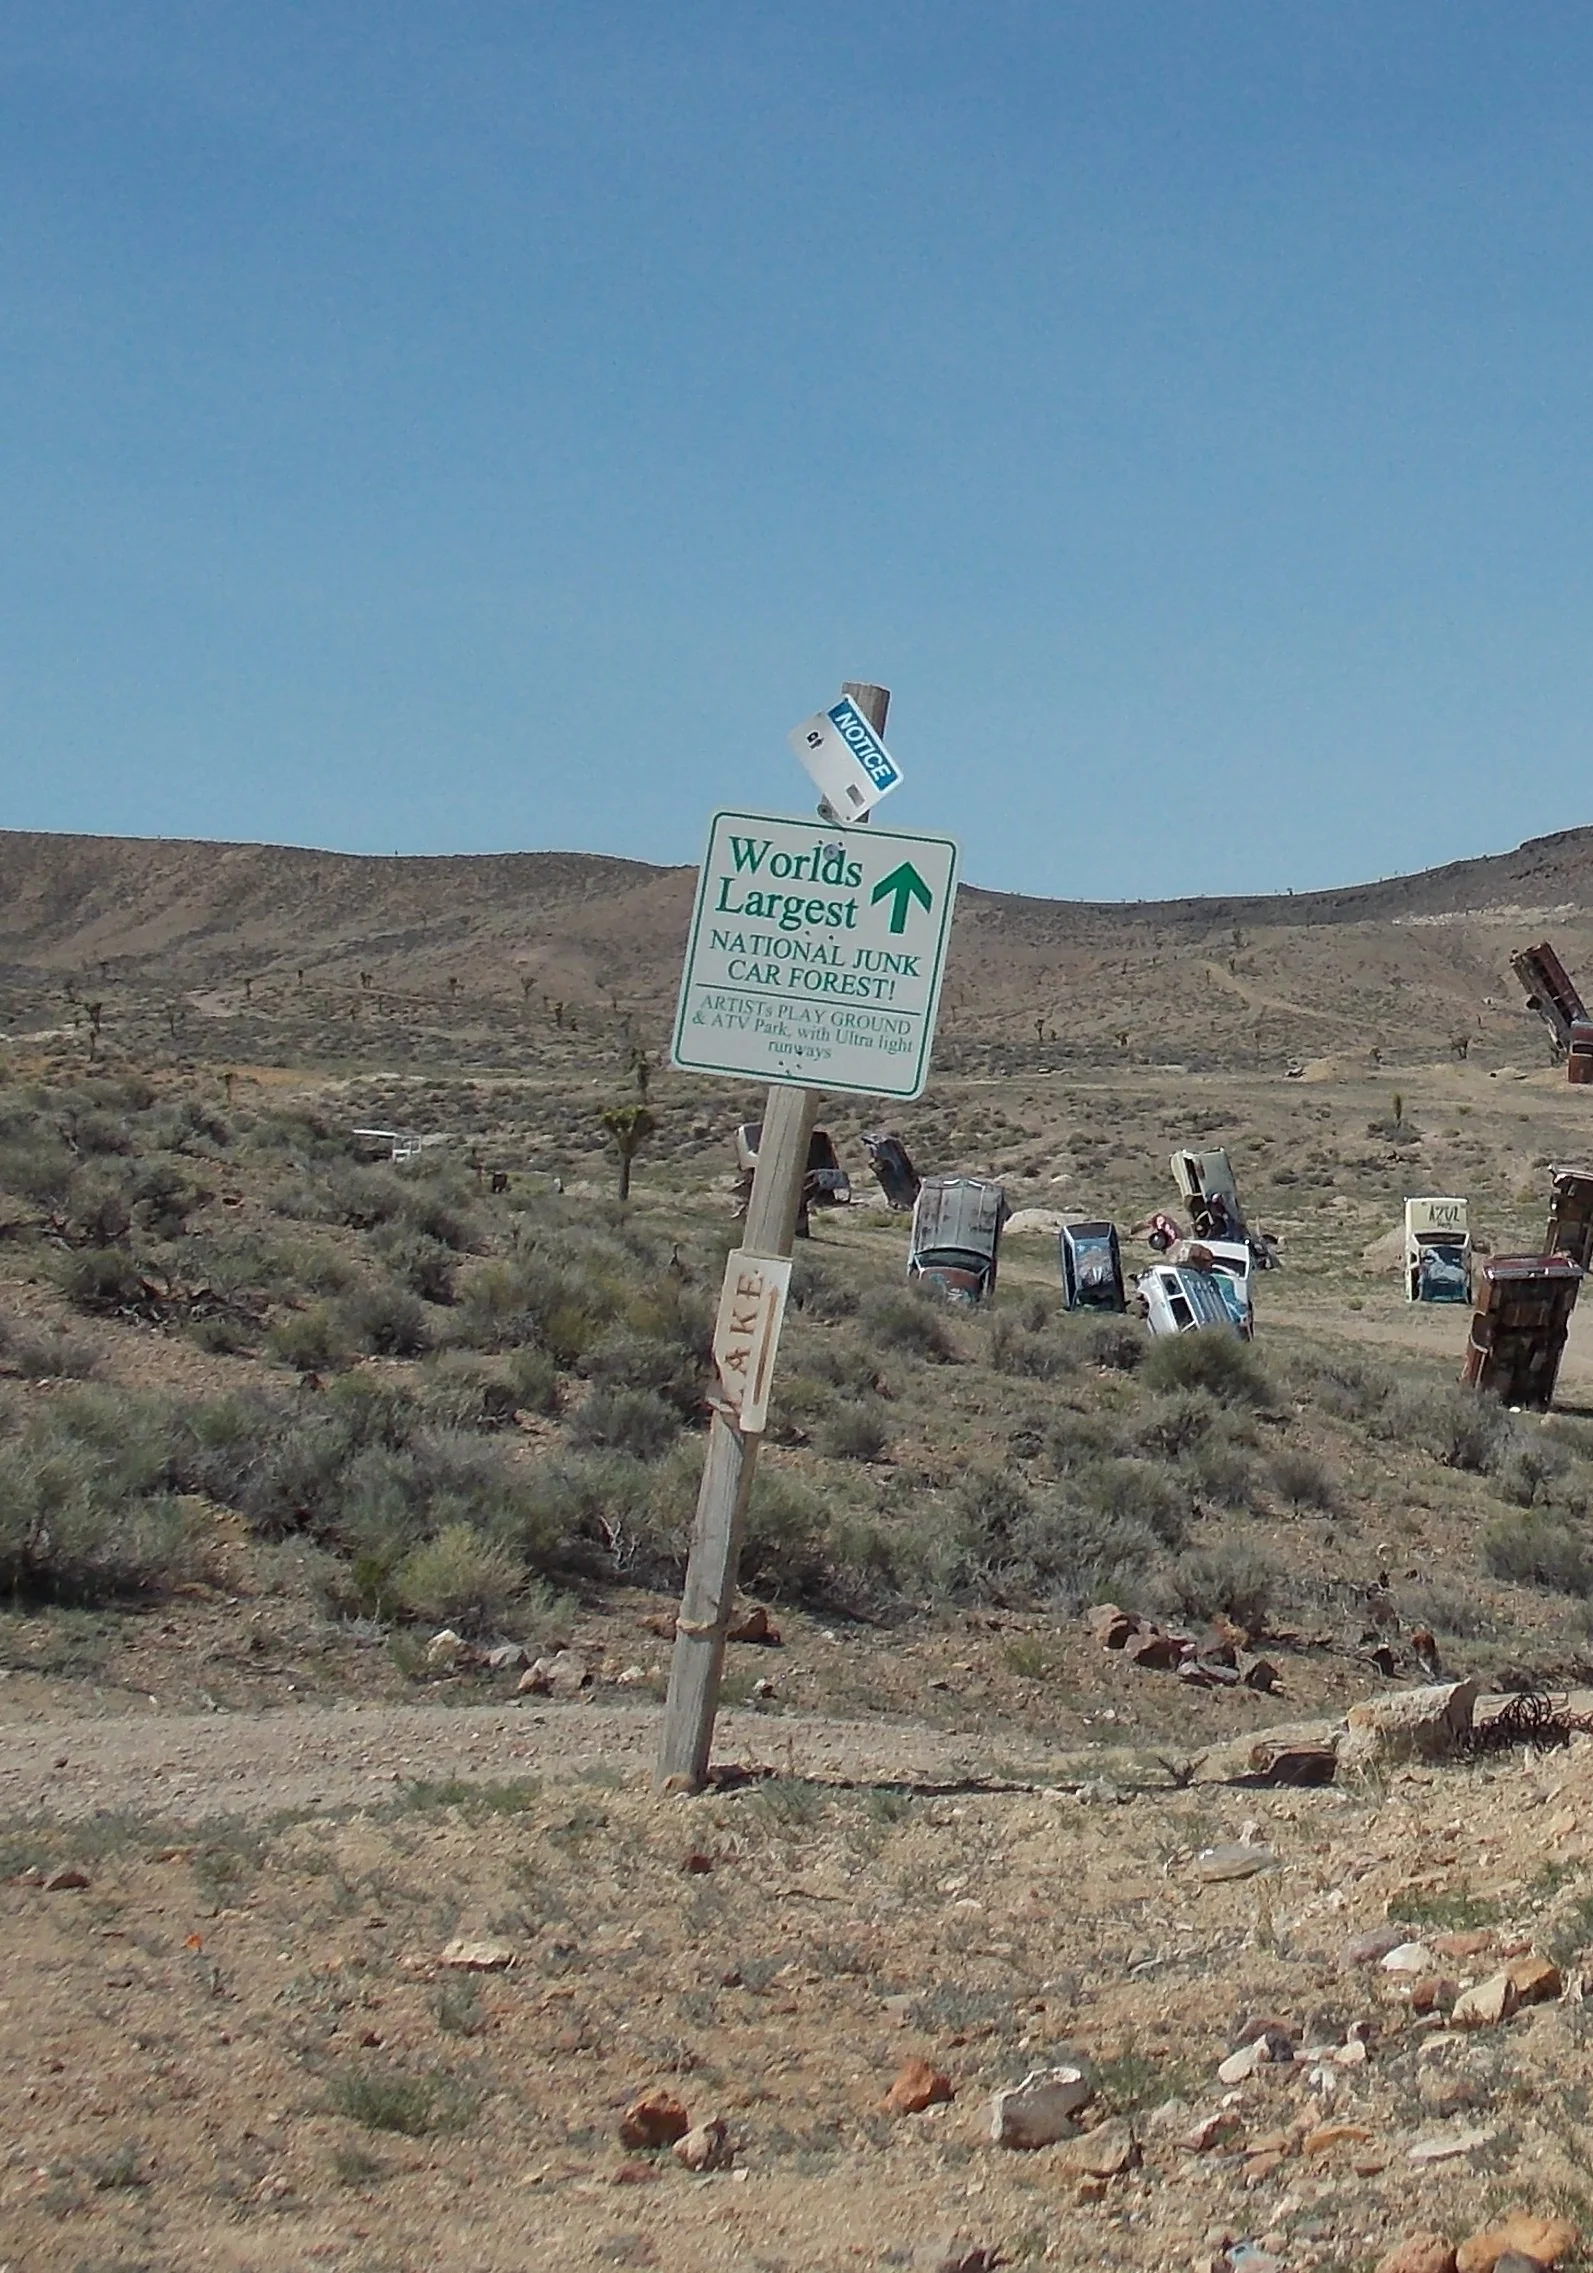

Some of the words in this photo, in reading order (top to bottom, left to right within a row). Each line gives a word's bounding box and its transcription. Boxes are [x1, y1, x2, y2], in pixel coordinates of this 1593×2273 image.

[835, 712, 891, 781] NOTICE
[728, 836, 863, 888] Worlds
[715, 876, 859, 932] Largest
[709, 929, 846, 967] NATIONAL
[853, 949, 923, 978] JUNK
[728, 959, 782, 986] CAR
[788, 967, 896, 1001] FOREST!
[692, 1010, 706, 1025] &
[711, 1013, 750, 1030] ATV
[797, 1025, 831, 1042] with
[835, 1028, 874, 1048] Ultra
[878, 1034, 913, 1055] light
[777, 1003, 826, 1024] PLAY
[831, 1011, 912, 1036] GROUND
[767, 1039, 832, 1061] runways
